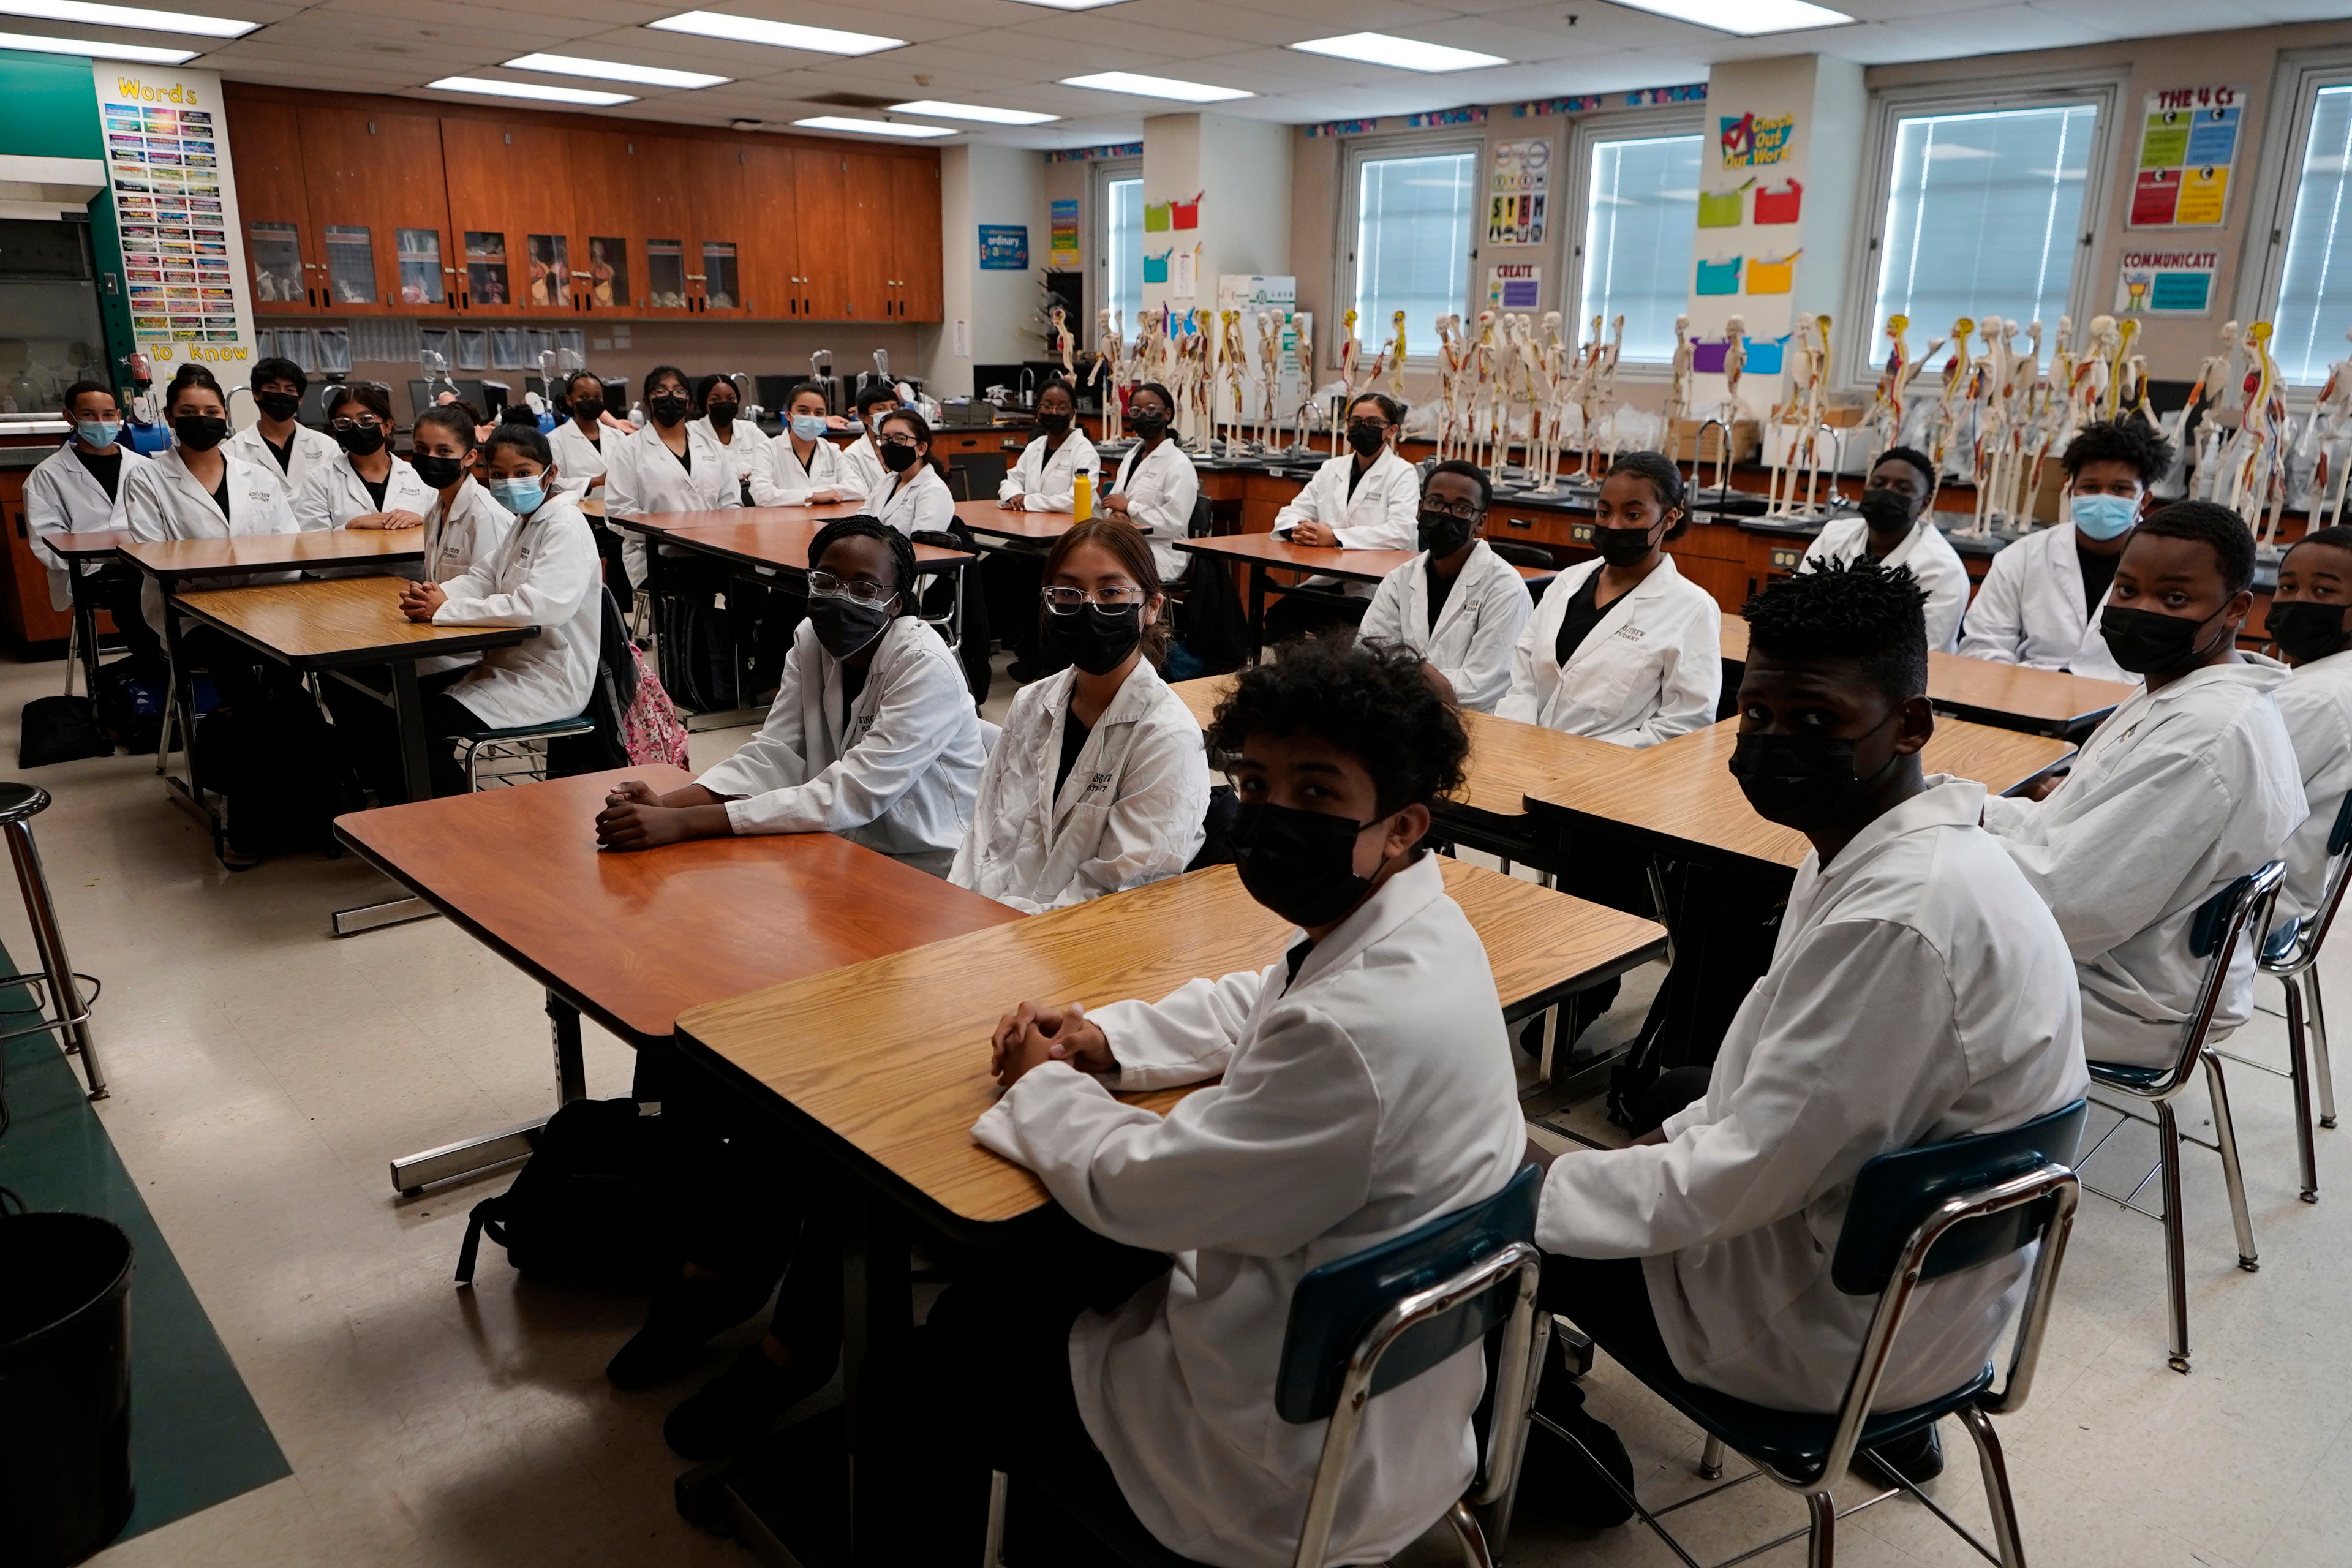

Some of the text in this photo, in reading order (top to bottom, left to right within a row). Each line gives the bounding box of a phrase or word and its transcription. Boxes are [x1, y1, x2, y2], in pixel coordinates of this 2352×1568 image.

[118, 77, 197, 105] Words
[2159, 86, 2234, 109] THE 4 Cs
[1752, 113, 1793, 133] Check
[1755, 129, 1781, 148] Out
[1723, 154, 1749, 171] Our
[987, 235, 1020, 248] ordinary
[2124, 252, 2217, 268] COMMUNICATE
[1497, 264, 1533, 278] CREATE
[151, 343, 248, 363] to know
